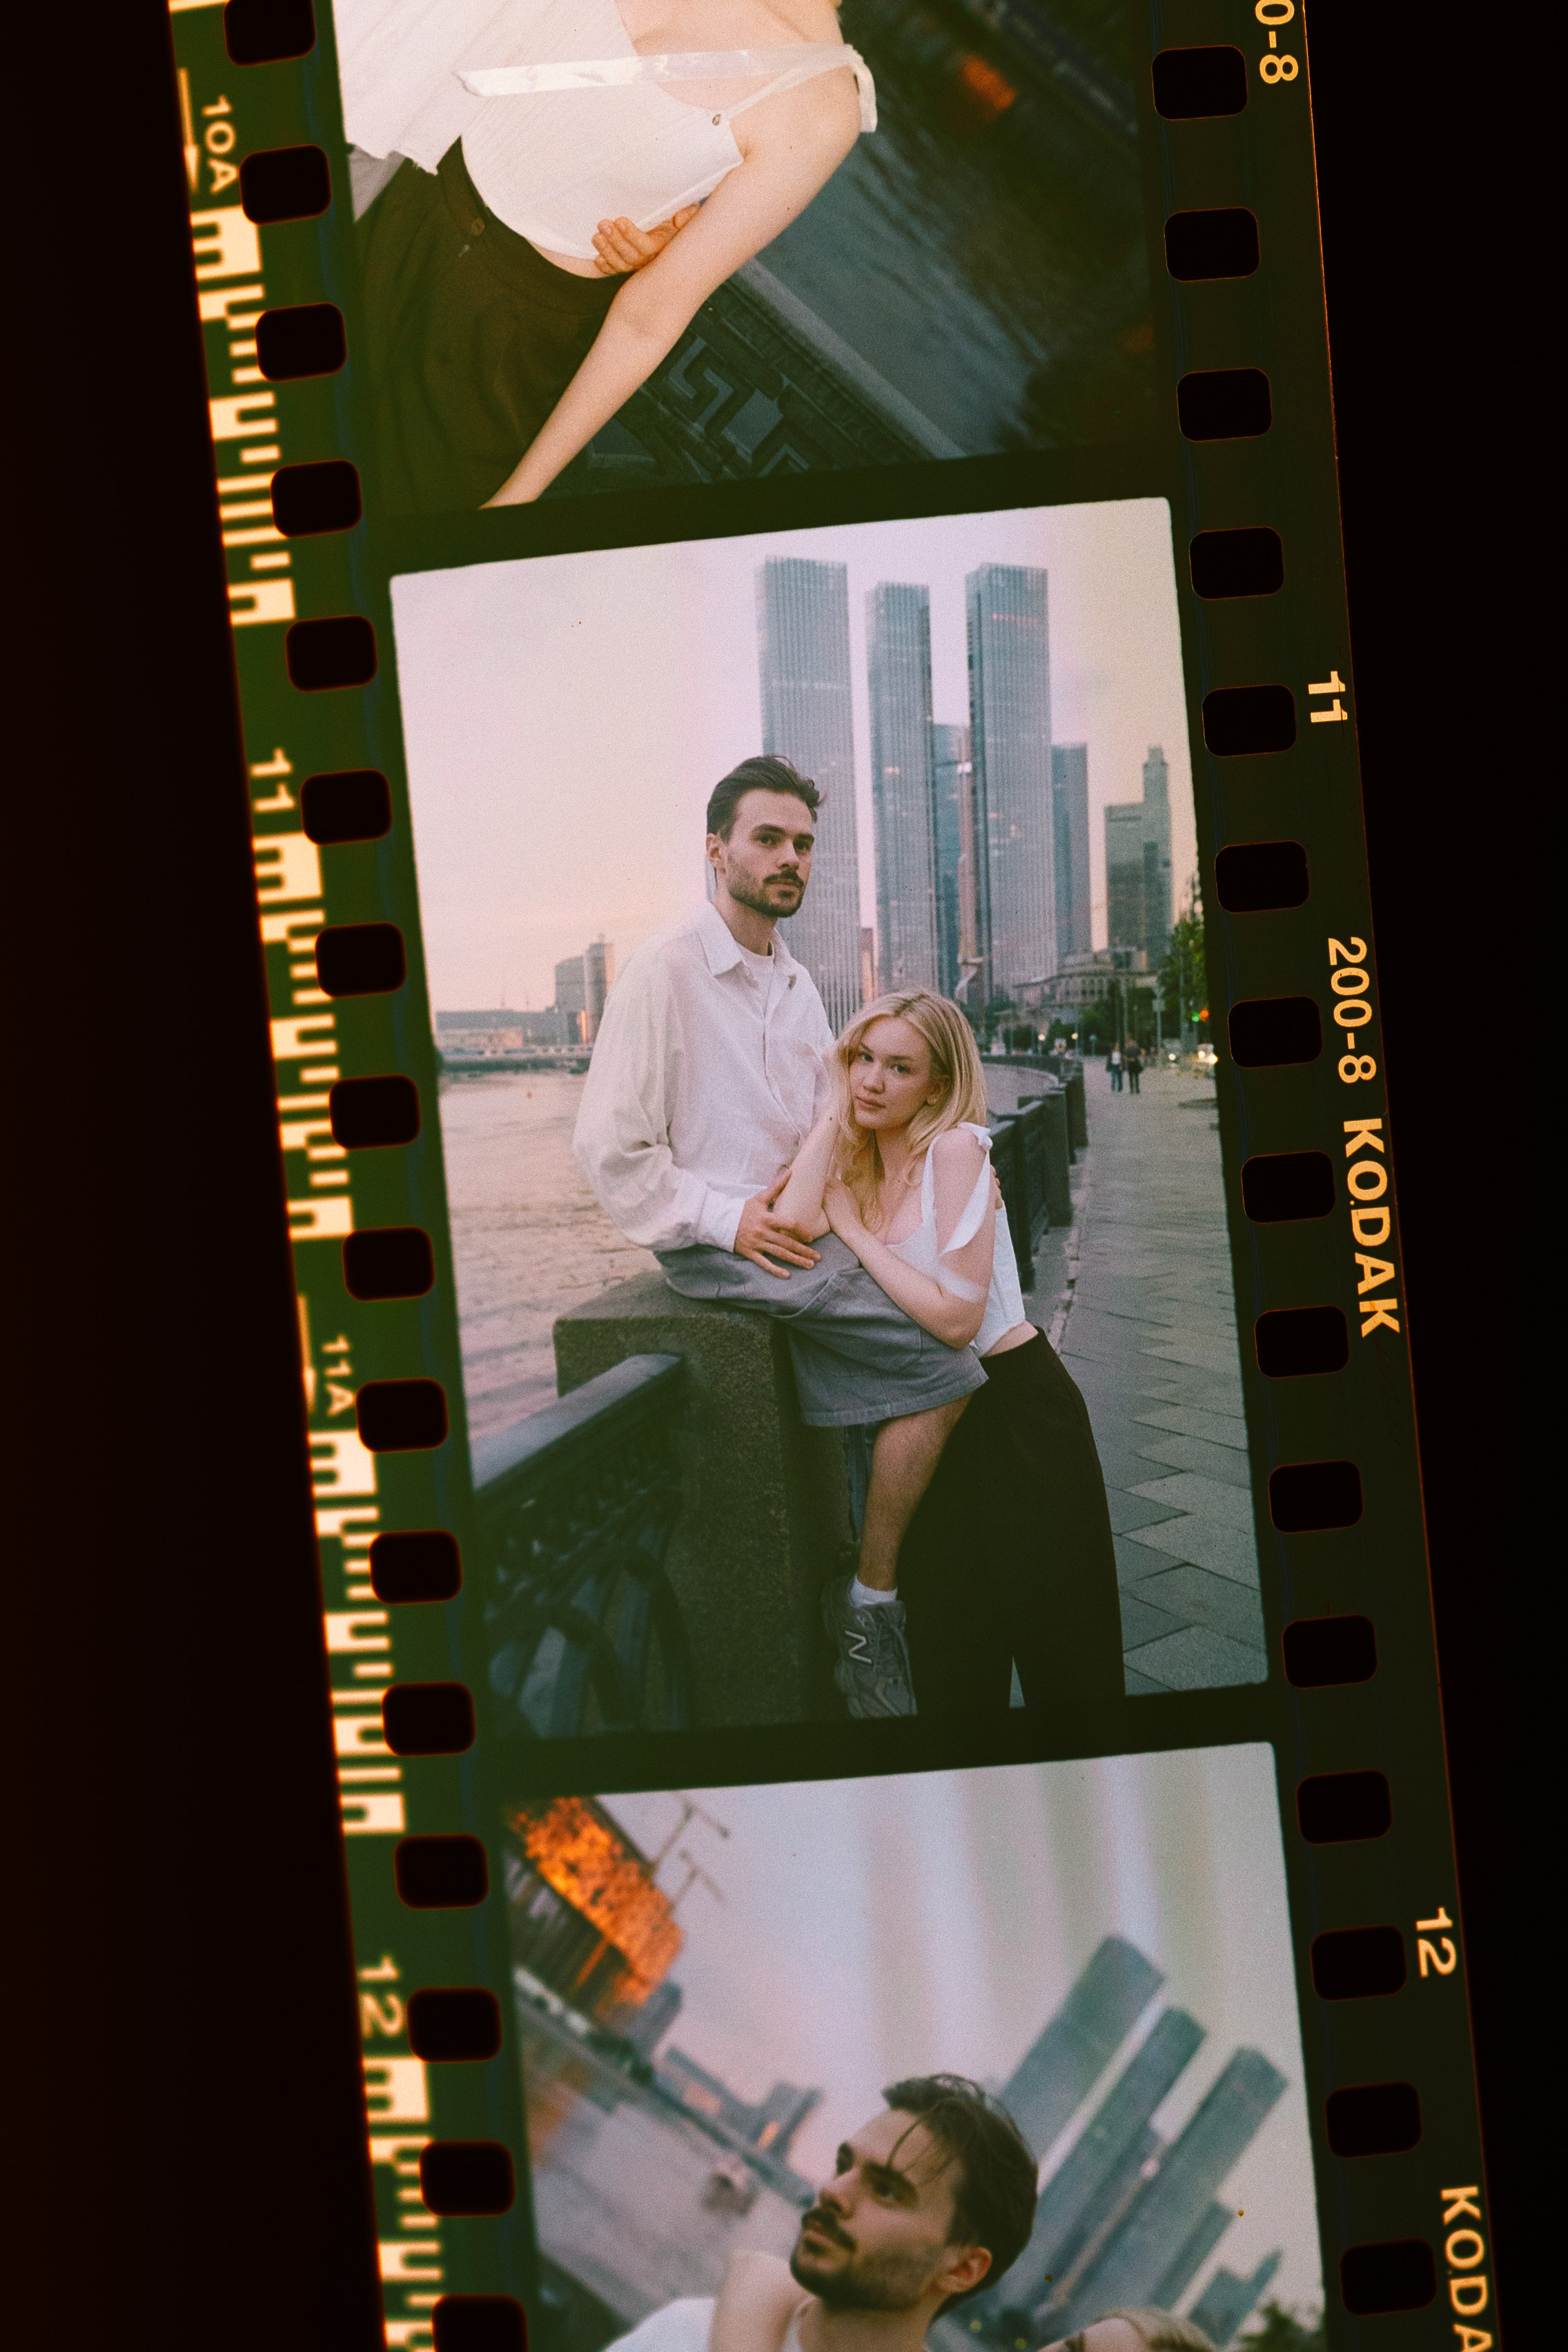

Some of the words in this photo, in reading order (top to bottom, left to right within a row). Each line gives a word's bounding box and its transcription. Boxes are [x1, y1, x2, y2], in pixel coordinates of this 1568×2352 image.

[1255, 0, 1298, 84] 0-8
[202, 95, 238, 194] 10A
[1308, 670, 1348, 723] 11
[250, 747, 295, 813] 11
[1329, 936, 1377, 1084] 200-8
[1343, 1117, 1400, 1338] KODAK
[322, 1333, 355, 1416] 11A
[844, 1629, 874, 1665] N
[1415, 1906, 1457, 1978] 12
[359, 1954, 404, 2038] 12
[1440, 2185, 1493, 2352] KODA
